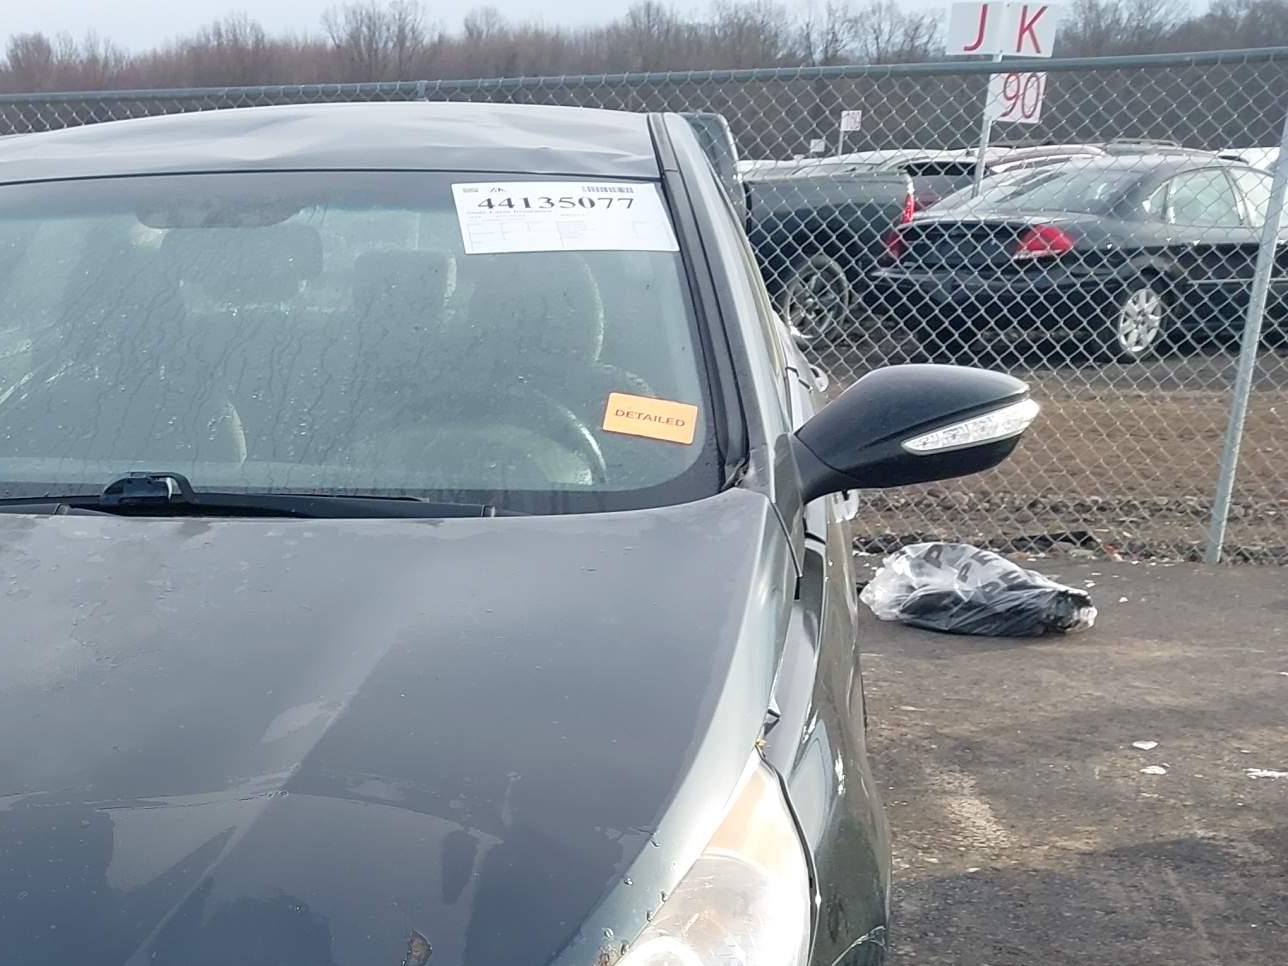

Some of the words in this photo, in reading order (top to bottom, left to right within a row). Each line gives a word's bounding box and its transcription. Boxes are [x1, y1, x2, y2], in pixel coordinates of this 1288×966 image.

[963, 3, 988, 52] J
[1016, 5, 1048, 54] K
[1001, 72, 1041, 119] 90
[477, 196, 635, 209] 44135077
[615, 408, 686, 427] DETAILED
